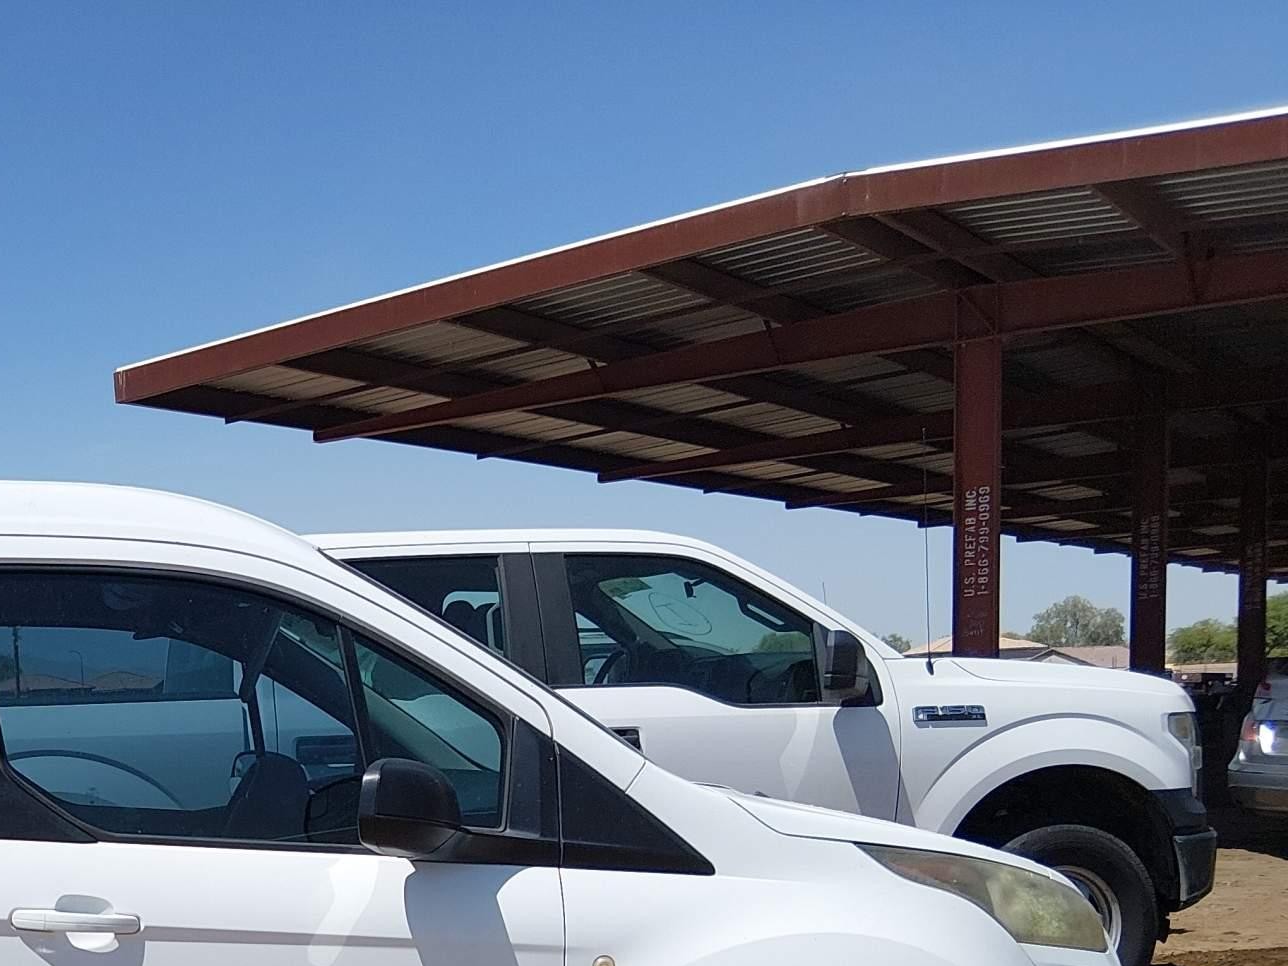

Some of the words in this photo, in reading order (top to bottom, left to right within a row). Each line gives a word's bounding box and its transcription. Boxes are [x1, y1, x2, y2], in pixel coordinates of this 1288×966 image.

[965, 486, 977, 511] INC.
[964, 517, 977, 567] PREFAB
[976, 486, 991, 596] 1-866-799-0969
[963, 572, 976, 598] U.S.
